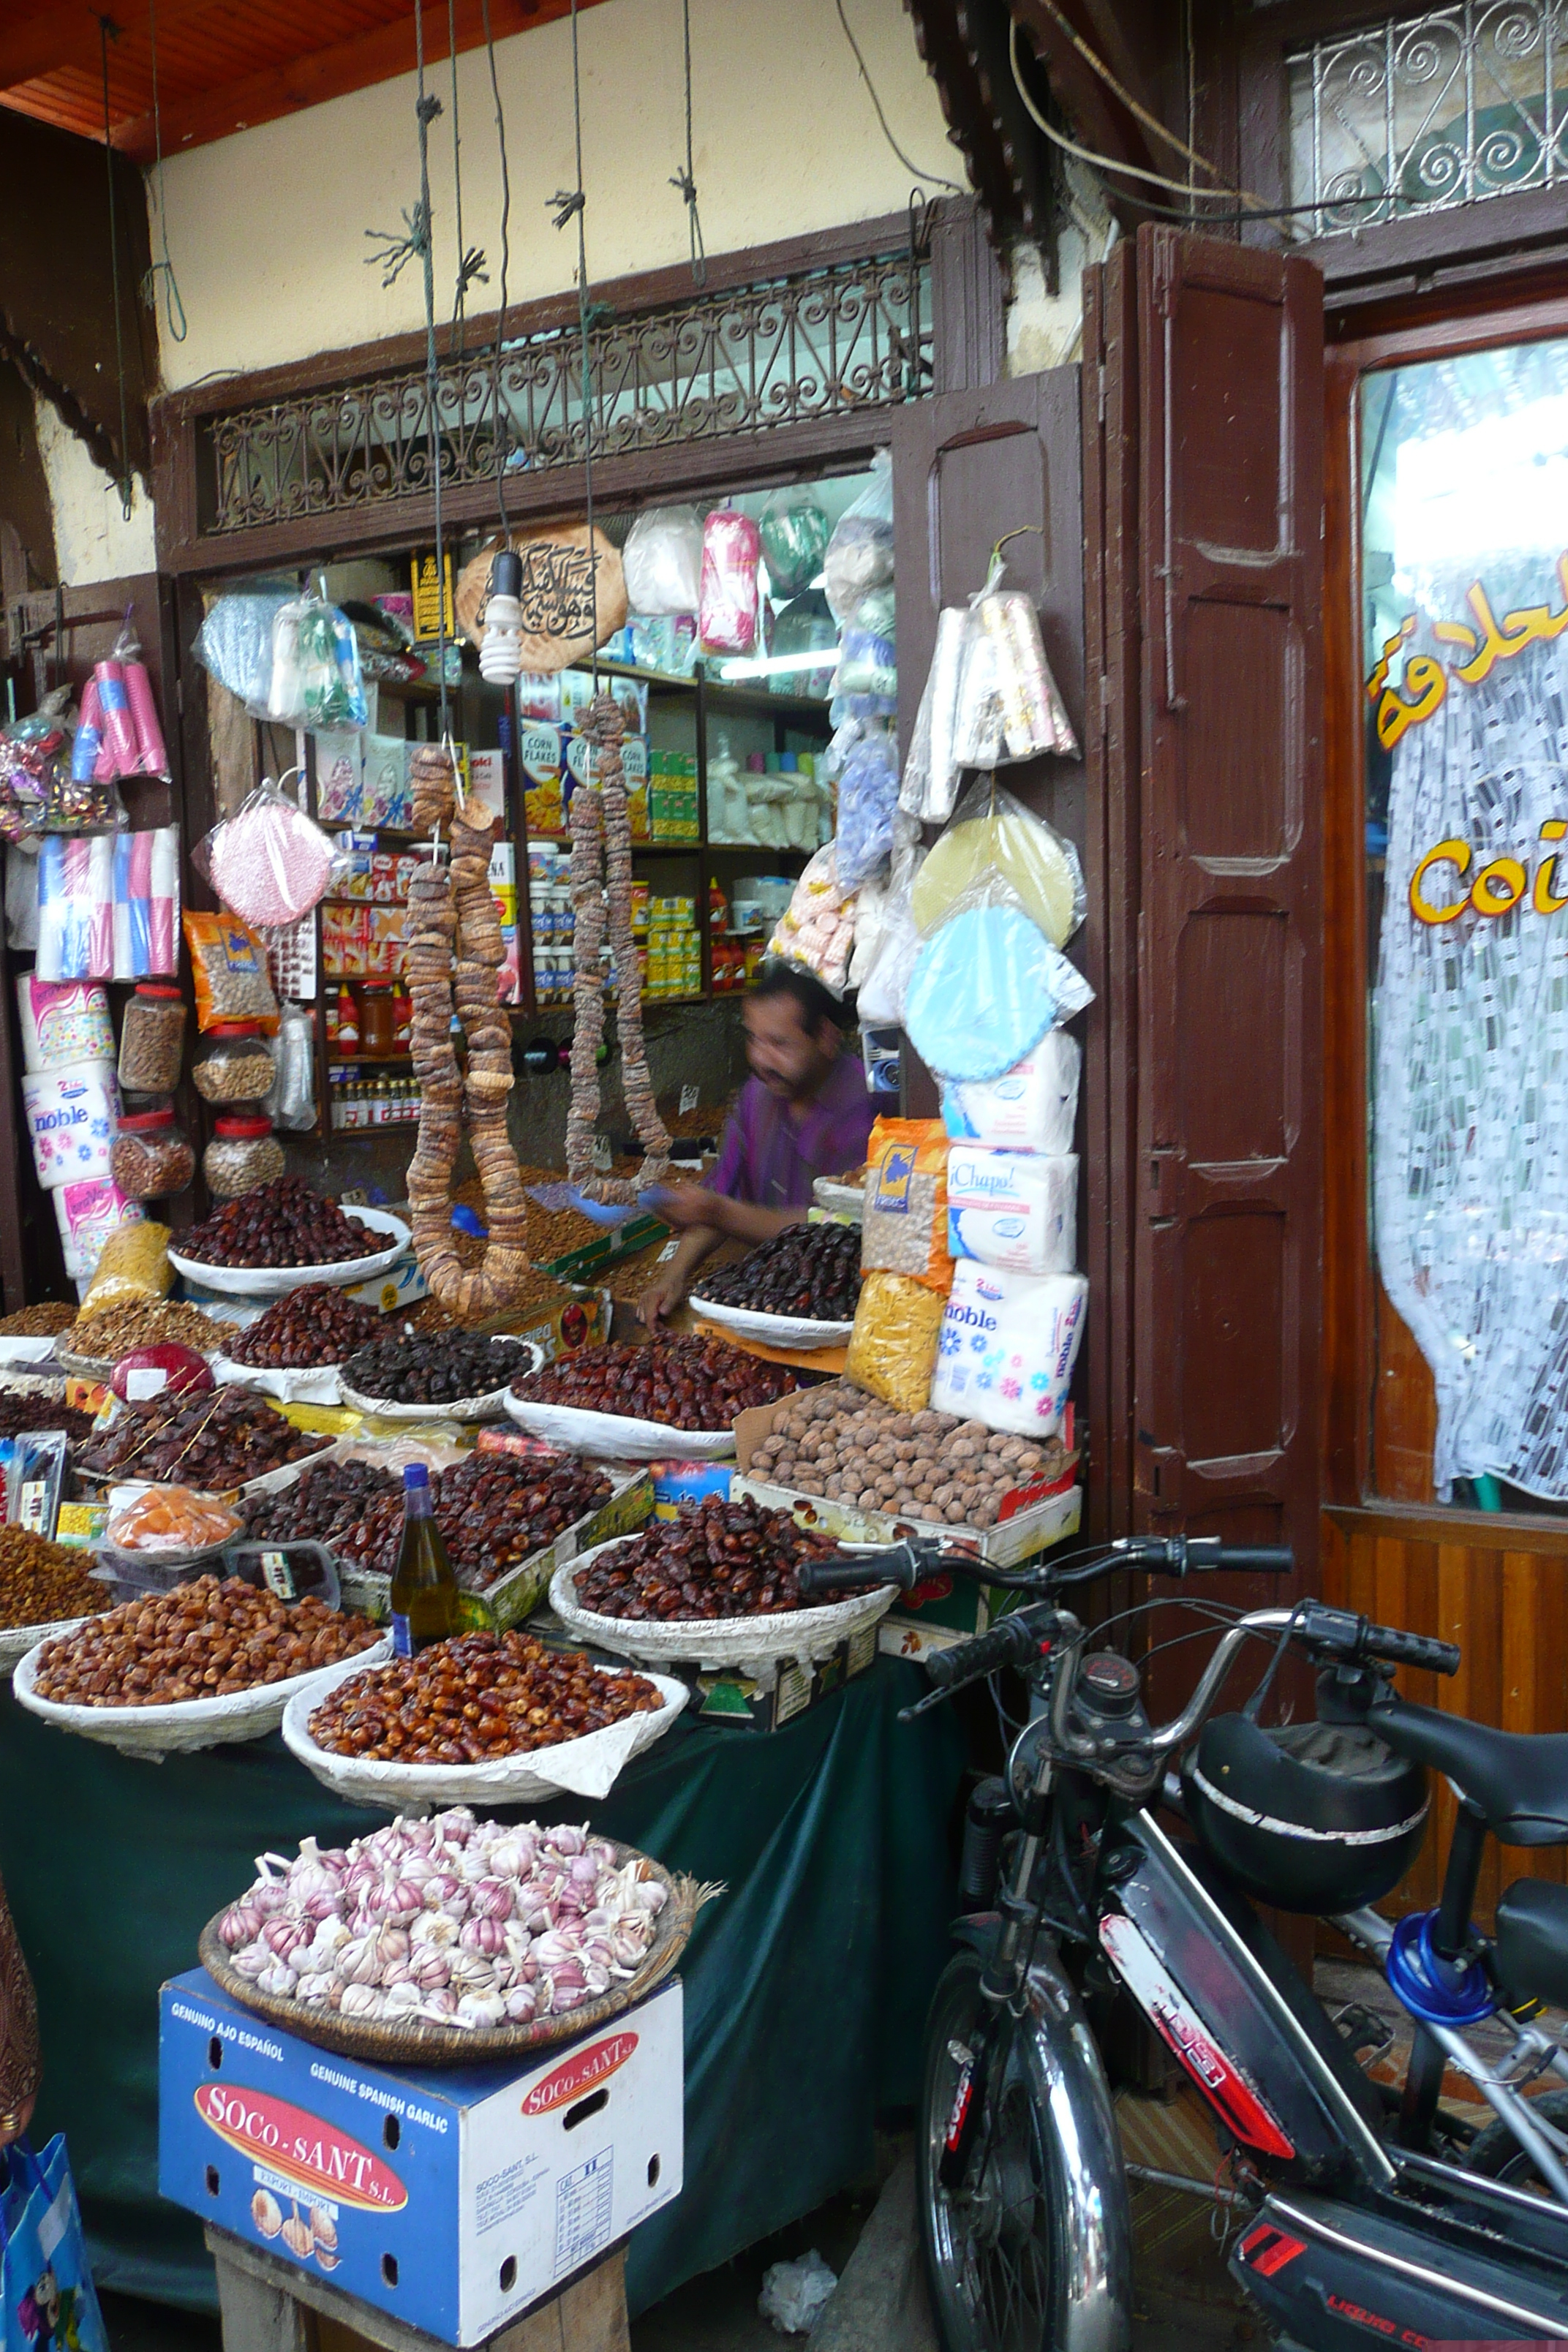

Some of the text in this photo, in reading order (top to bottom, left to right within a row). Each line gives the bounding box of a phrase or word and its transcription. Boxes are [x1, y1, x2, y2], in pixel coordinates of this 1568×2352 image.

[527, 737, 552, 747] CORN
[524, 750, 556, 764] FLAKES
[34, 1106, 89, 1132] noble
[945, 1304, 998, 1331] noble
[170, 2002, 284, 2062] GENUINO AJO ESPAÑOL
[309, 2062, 448, 2134] GENUINE SPANISH GARLIC
[1326, 2293, 1397, 2335] LIQUID
